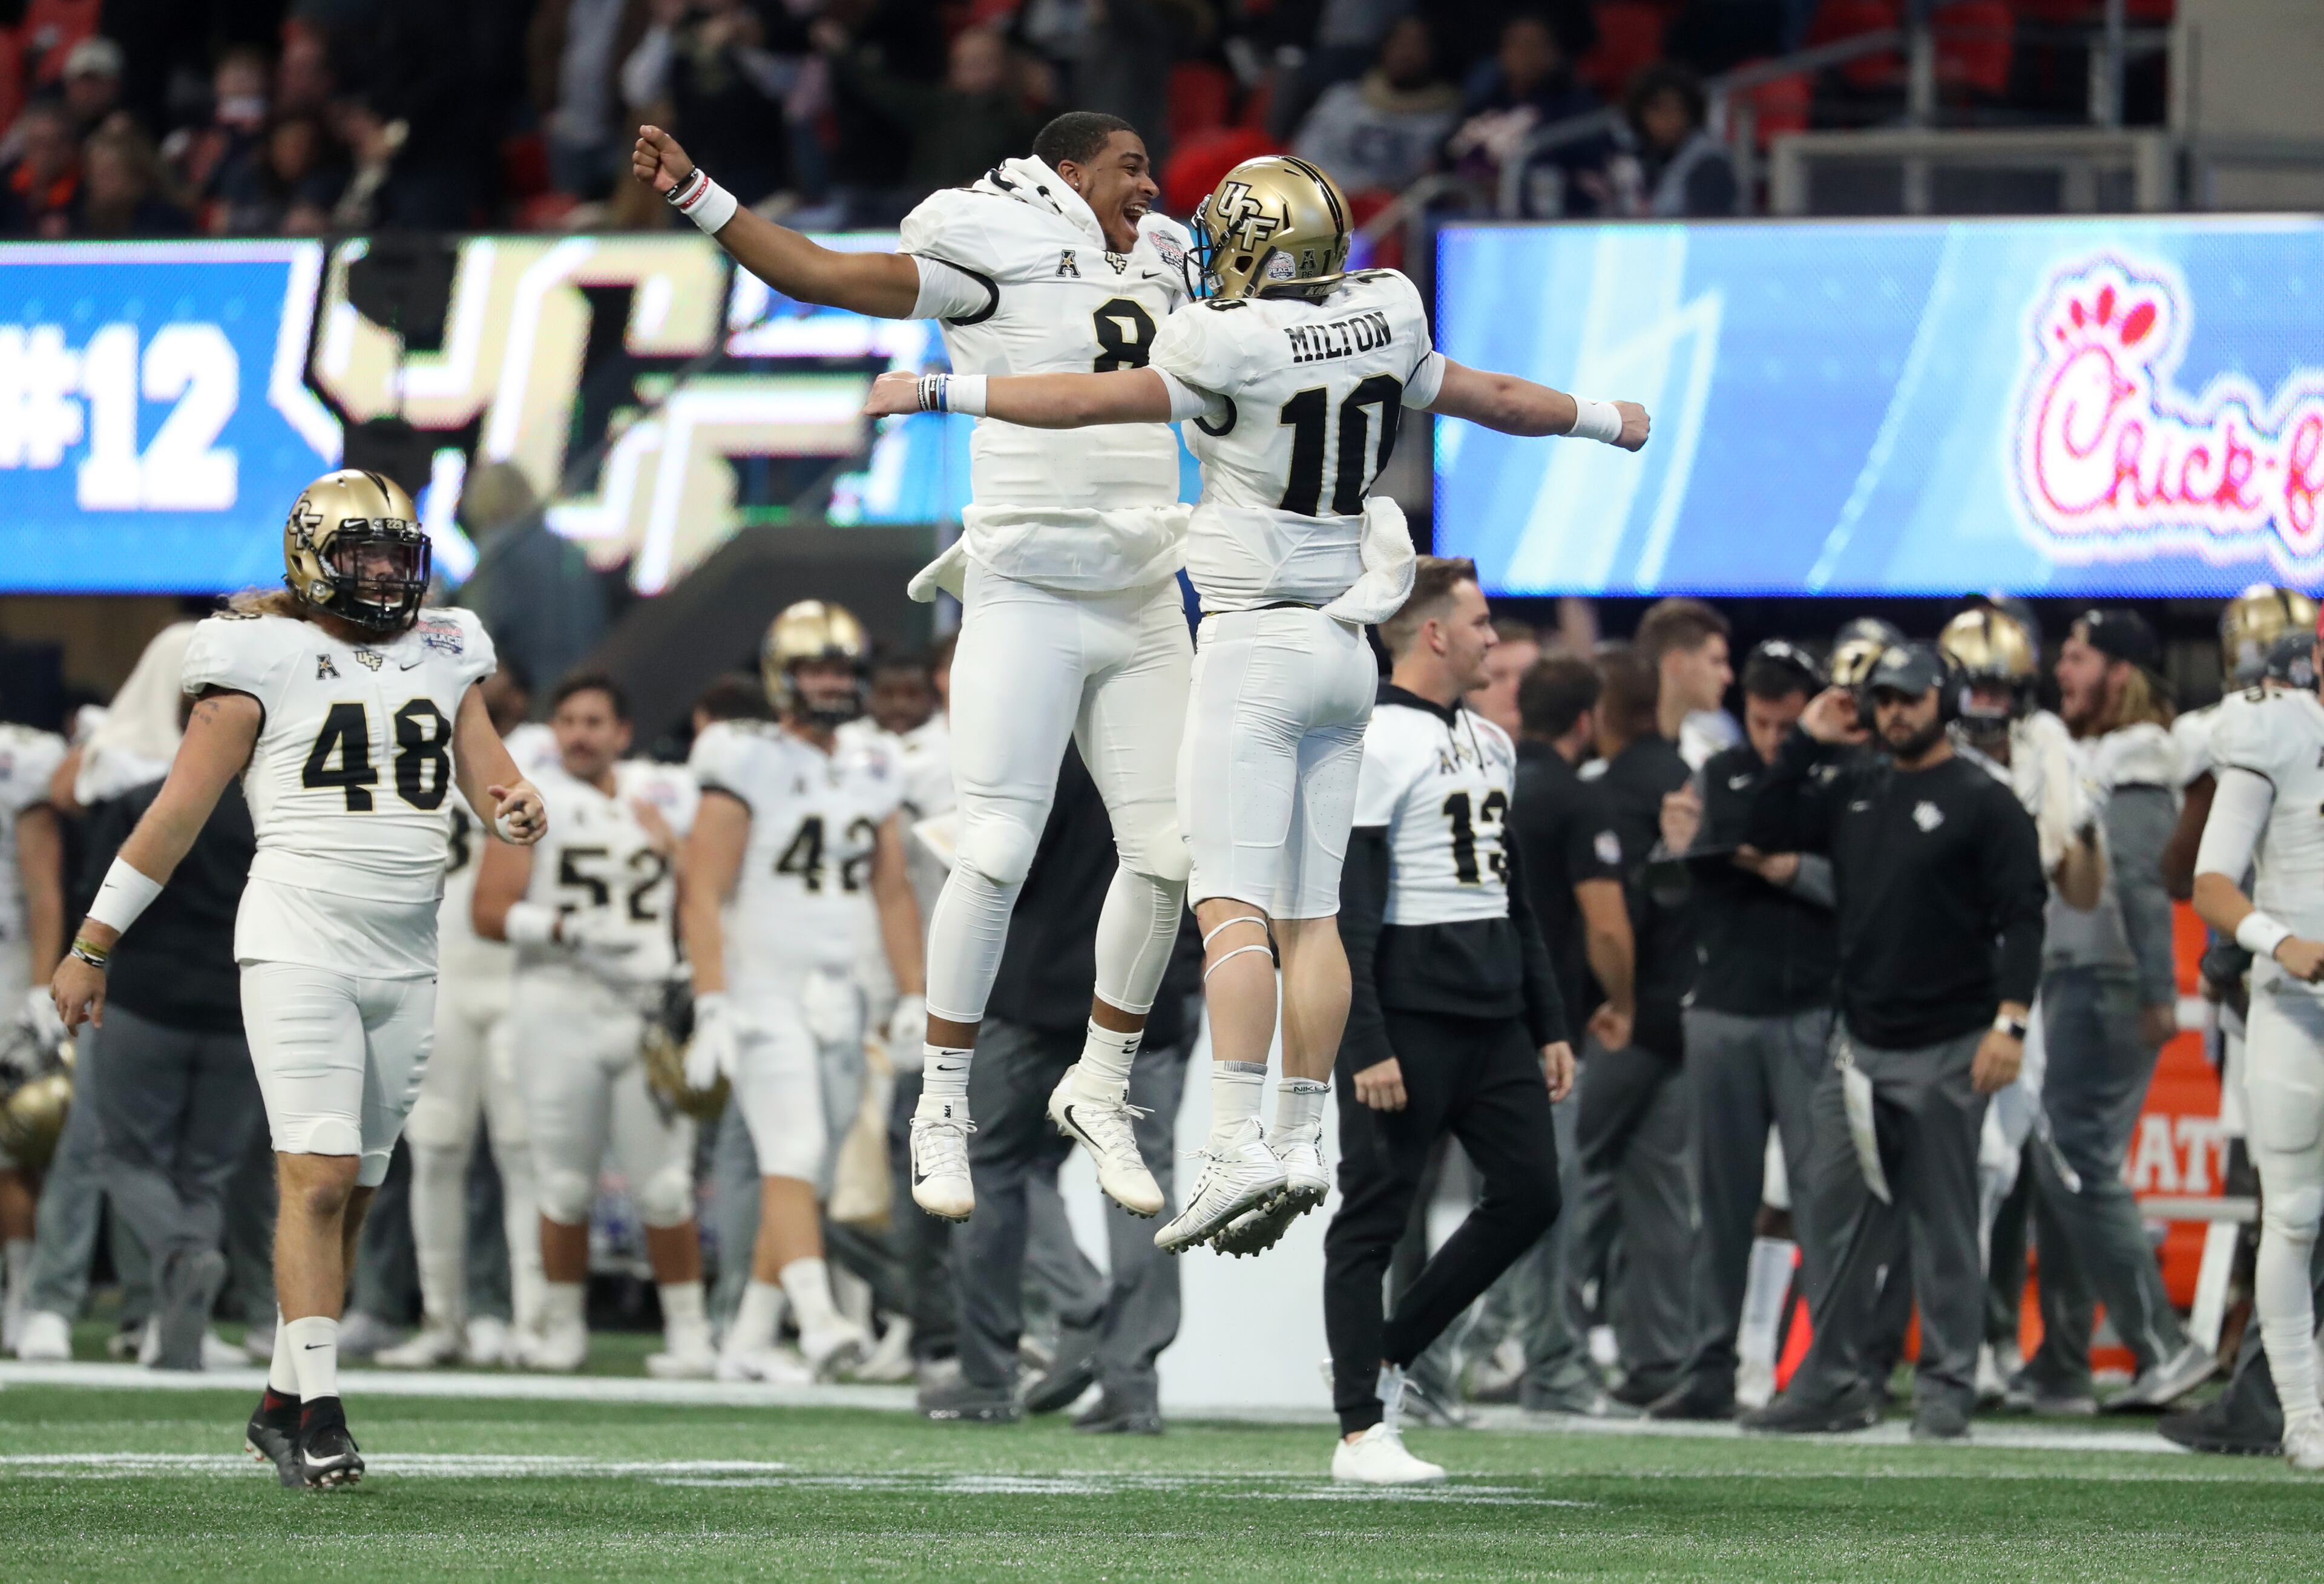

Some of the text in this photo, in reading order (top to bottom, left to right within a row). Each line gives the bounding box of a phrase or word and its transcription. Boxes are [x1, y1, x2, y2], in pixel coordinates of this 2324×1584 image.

[1217, 181, 1280, 253] UCF
[1104, 250, 1127, 275] UCF
[1268, 266, 1293, 275] PEACH
[1091, 294, 1158, 373] 8
[1283, 311, 1391, 363] MILTON
[0, 323, 238, 511] #12
[1278, 370, 1404, 518] 10
[355, 650, 382, 671] UCF
[422, 633, 462, 648] PEACH
[301, 699, 451, 814] 48
[559, 844, 669, 921] 52
[2121, 1115, 2228, 1189] AT
